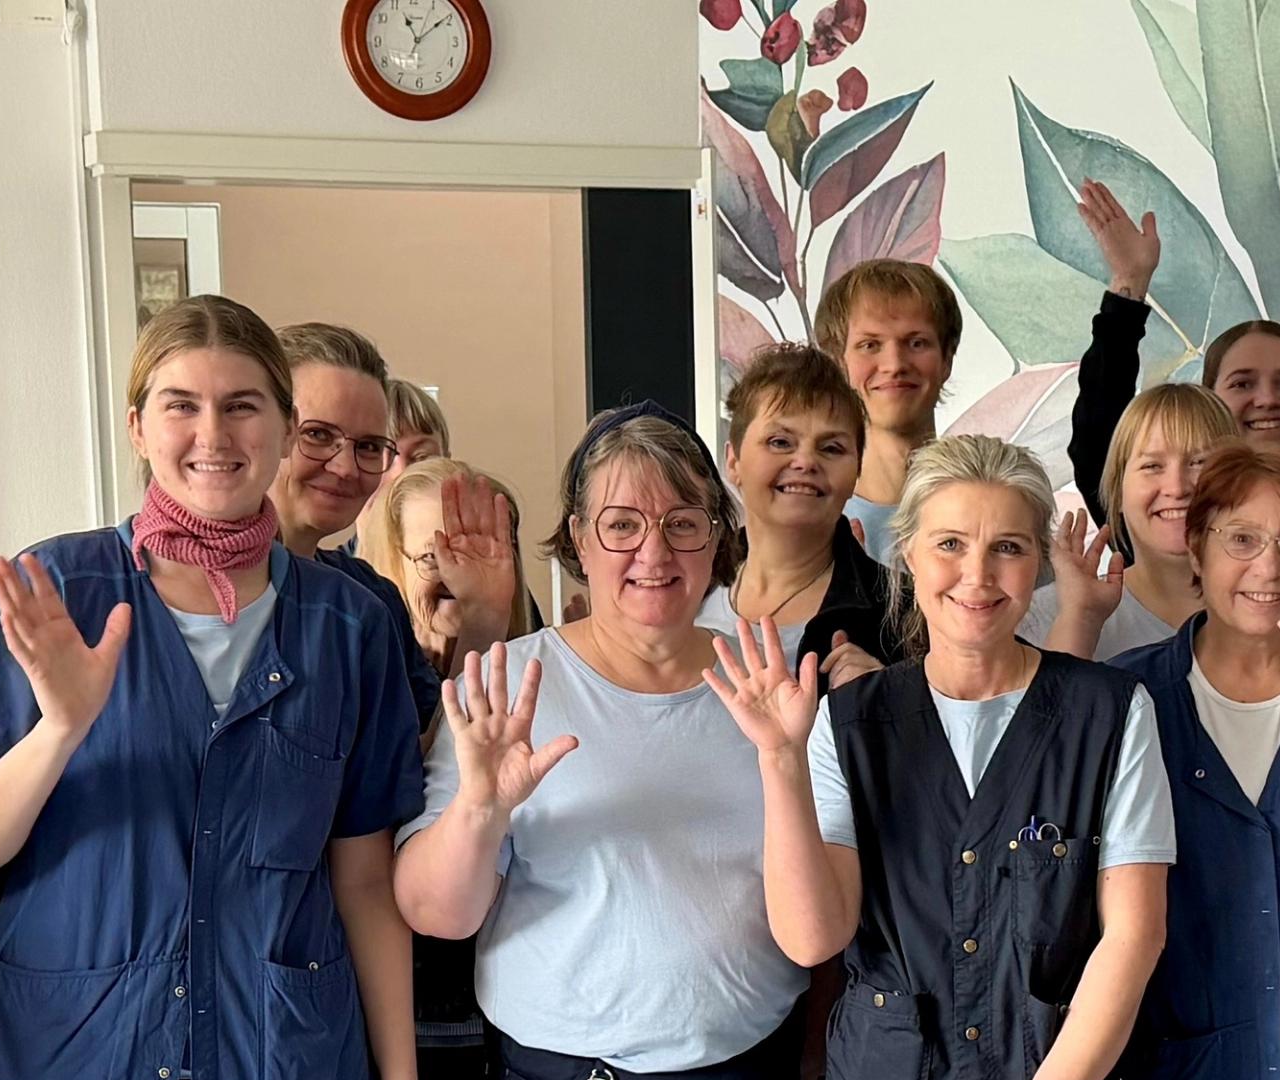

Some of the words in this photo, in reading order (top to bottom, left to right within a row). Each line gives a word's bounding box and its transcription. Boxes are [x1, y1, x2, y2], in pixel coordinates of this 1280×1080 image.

[377, 13, 388, 24] 10
[445, 13, 453, 26] 2
[374, 36, 382, 48] 9
[452, 36, 459, 48] 3
[381, 56, 389, 68] 8
[447, 56, 454, 68] 4
[397, 72, 405, 84] 7
[415, 77, 423, 89] 6
[434, 71, 442, 84] 5
